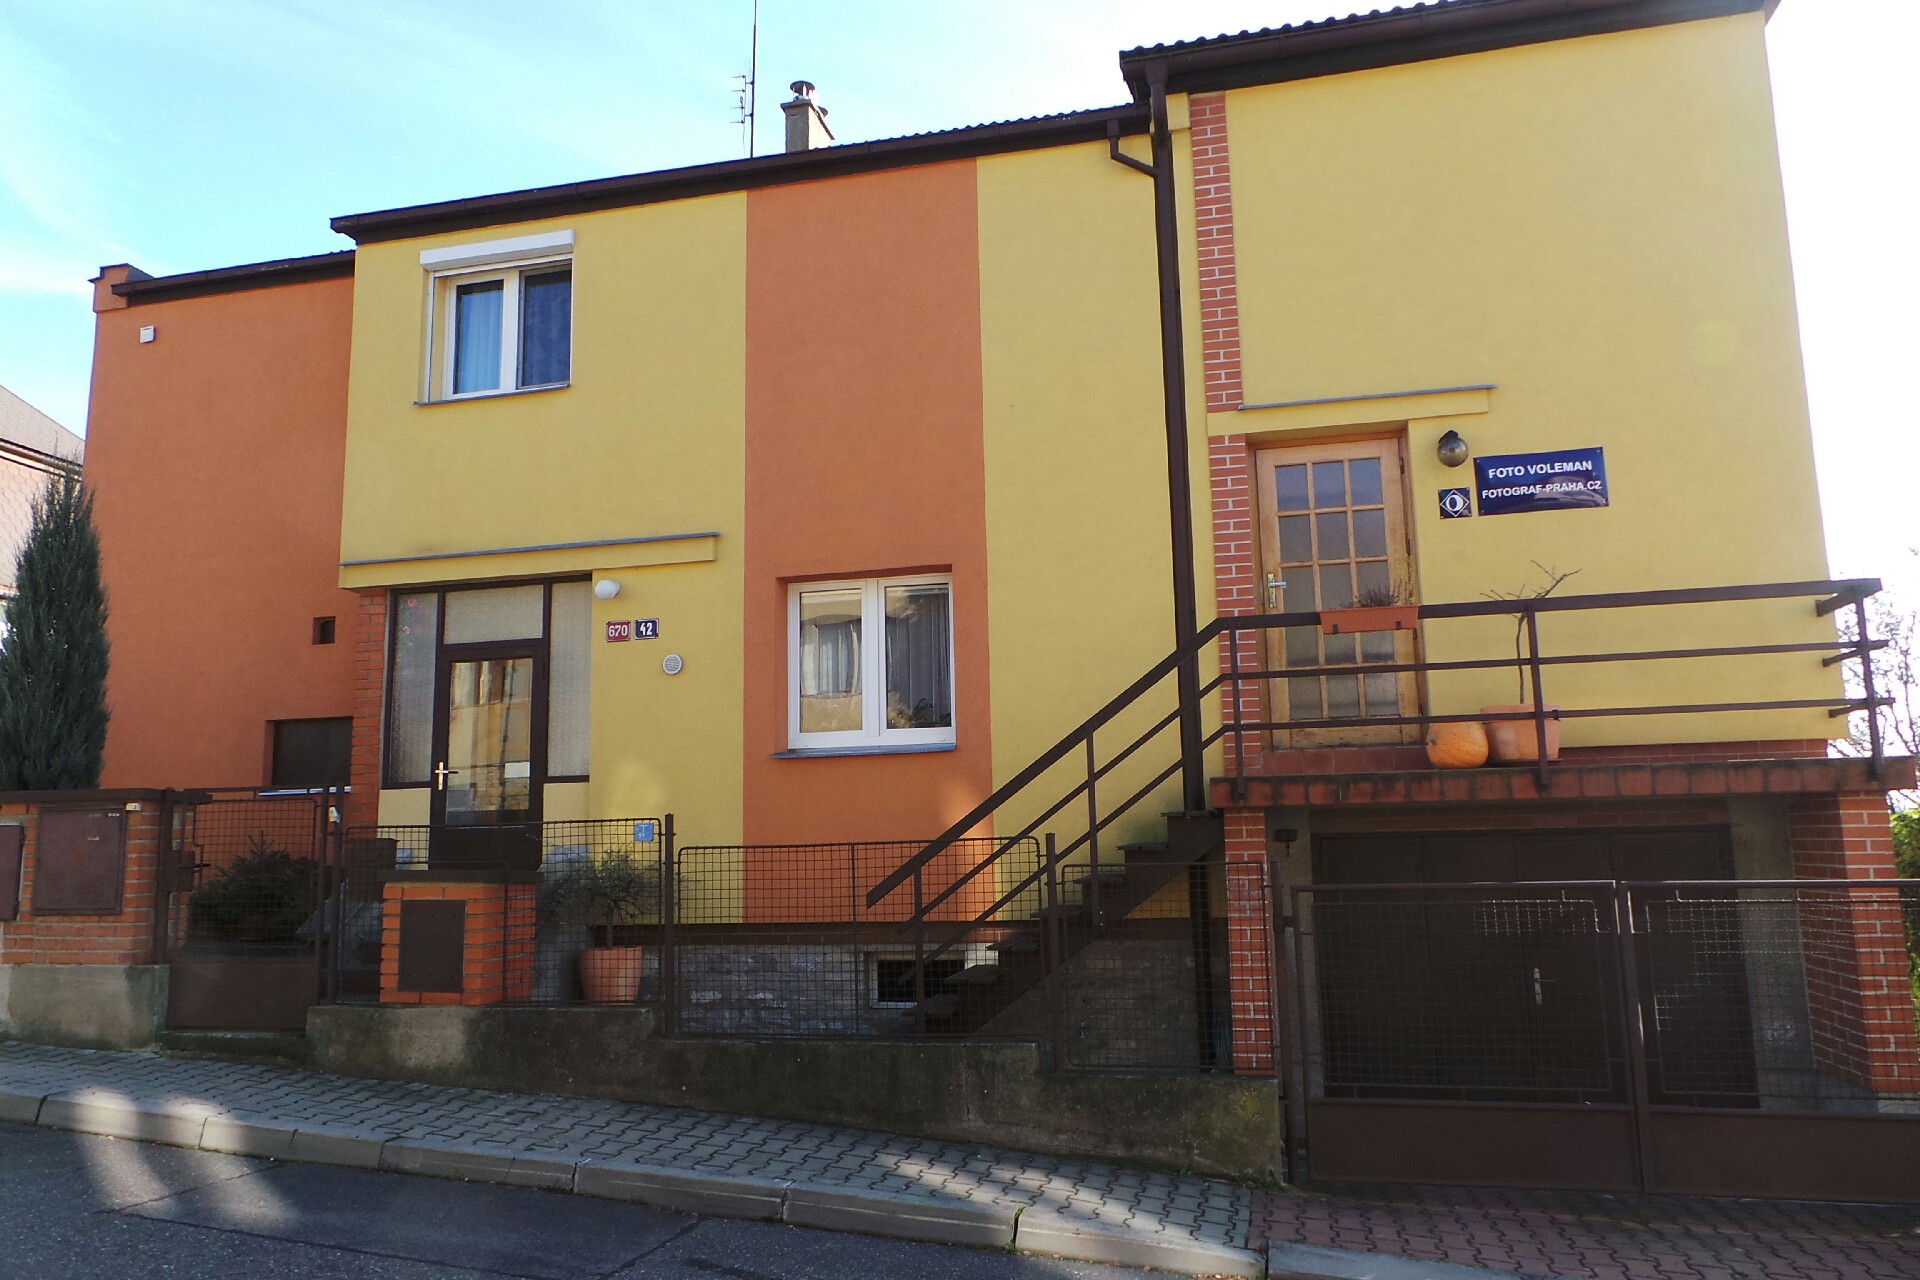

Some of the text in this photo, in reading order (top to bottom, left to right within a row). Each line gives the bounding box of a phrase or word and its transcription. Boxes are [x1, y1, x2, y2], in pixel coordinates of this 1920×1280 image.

[1488, 460, 1593, 479] FOTO VOLEMAN
[1482, 480, 1603, 499] FOTOGRAF-PRAHA.CZ
[608, 624, 628, 637] 670
[639, 622, 653, 636] 42
